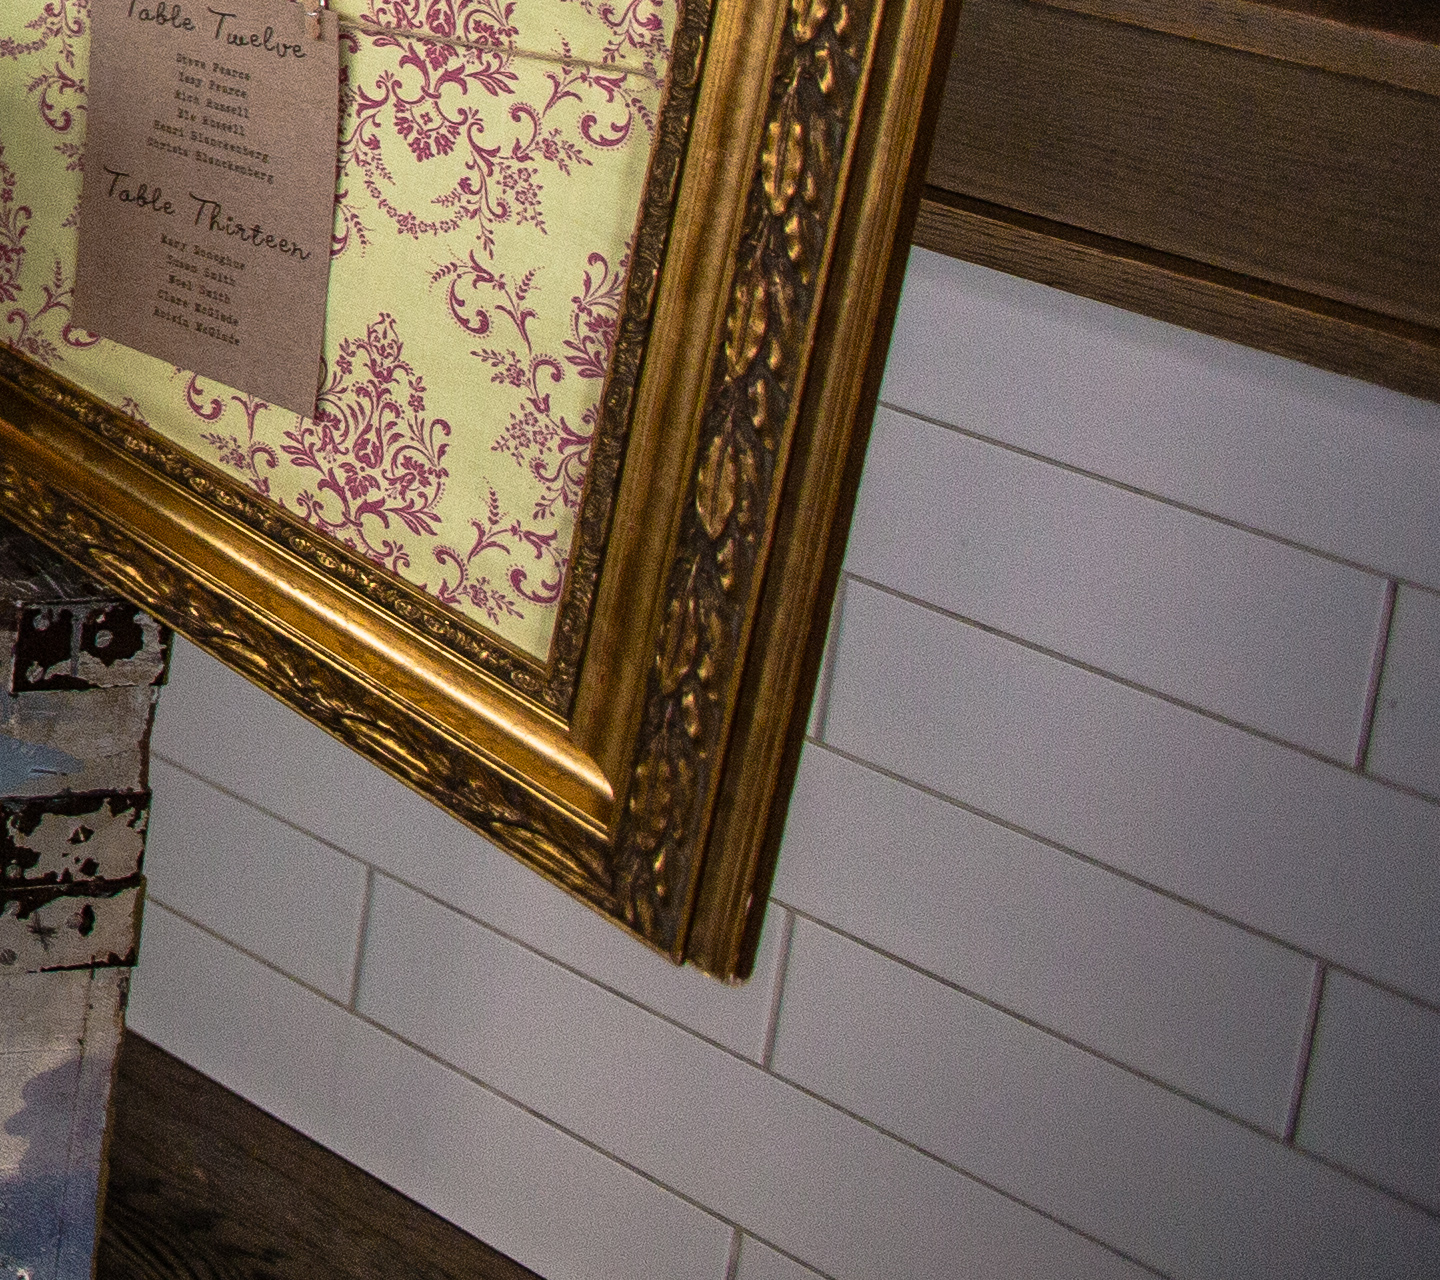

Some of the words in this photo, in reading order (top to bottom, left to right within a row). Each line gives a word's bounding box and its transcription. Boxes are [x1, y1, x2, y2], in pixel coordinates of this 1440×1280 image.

[207, 6, 307, 58] Twelve
[103, 165, 175, 215] Table
[189, 192, 311, 260] Thirteen
